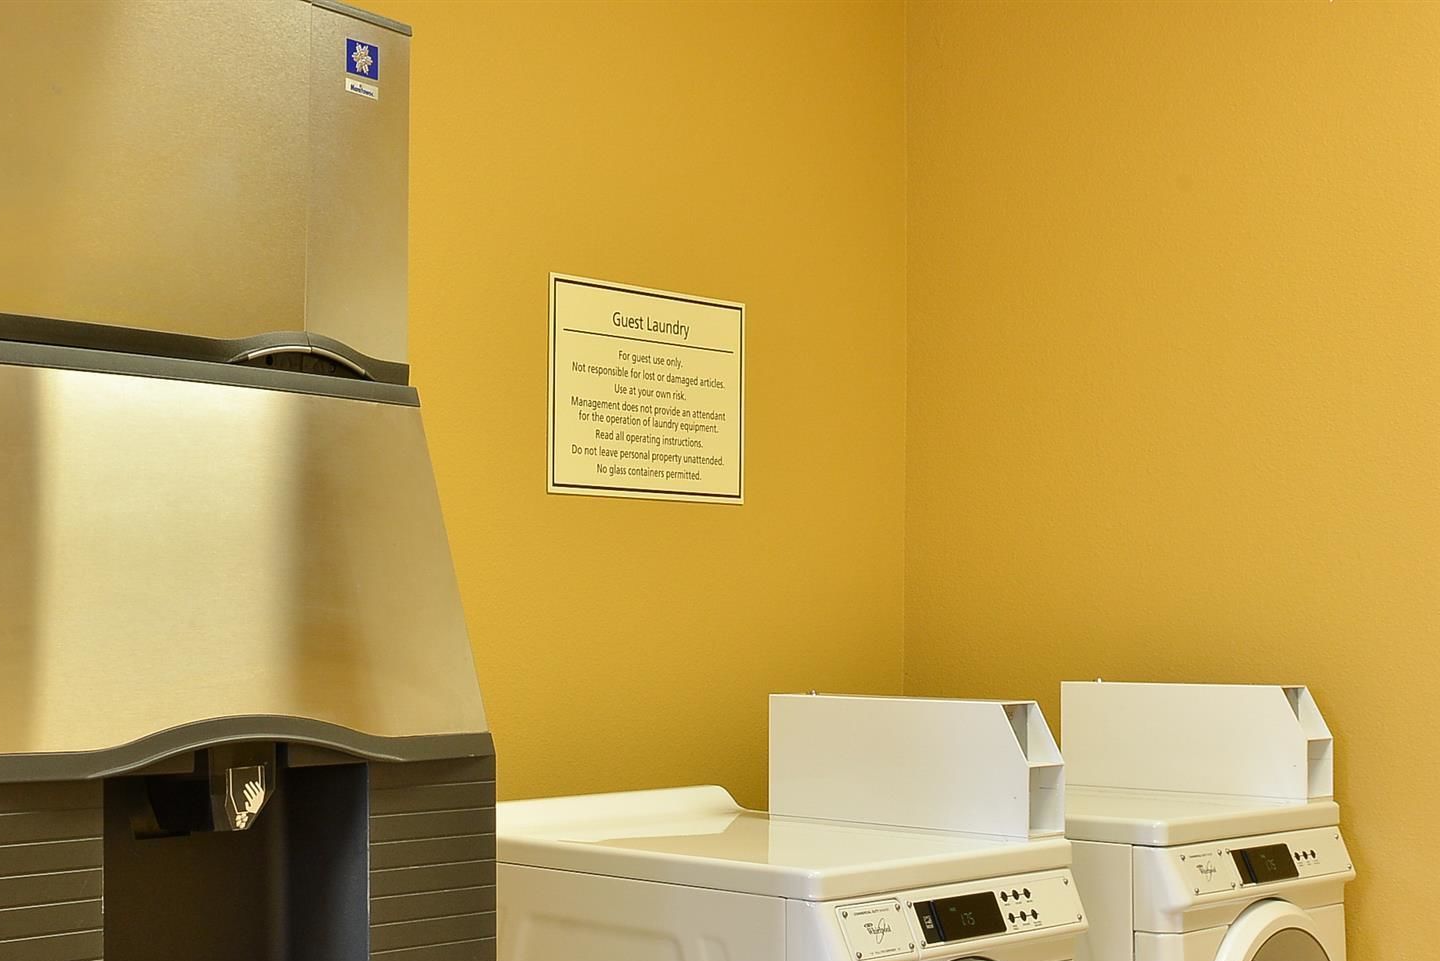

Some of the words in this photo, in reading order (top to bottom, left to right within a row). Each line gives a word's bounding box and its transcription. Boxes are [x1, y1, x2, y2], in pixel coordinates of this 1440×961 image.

[612, 311, 644, 330] Guest
[647, 317, 690, 340] Laundry
[618, 350, 630, 360] For
[632, 354, 651, 364] guest
[653, 357, 665, 365] use
[666, 357, 683, 370] only.
[572, 361, 586, 372] Not
[588, 365, 628, 377] responsible
[630, 368, 640, 378] for
[642, 370, 655, 380] lost
[657, 373, 665, 382] or
[666, 373, 698, 387] damaged
[700, 378, 725, 388] articles.
[614, 384, 627, 394] Use
[629, 386, 636, 396] at
[638, 388, 654, 398] your
[656, 390, 671, 399] own
[673, 390, 686, 400] risk.
[571, 396, 620, 410] Management
[622, 401, 638, 412] does
[640, 404, 653, 414] not
[654, 406, 680, 416] provide
[692, 410, 726, 421] attendant
[579, 410, 590, 420] for
[592, 412, 604, 422] the
[606, 415, 641, 426] operation
[642, 417, 651, 426] of
[652, 417, 679, 432] laundry
[680, 422, 719, 433] equipment.
[595, 429, 614, 440] Read
[616, 431, 624, 440] all
[626, 433, 660, 447] operating
[662, 435, 703, 448] instructions.
[572, 444, 582, 454] Do
[584, 447, 597, 456] not
[599, 445, 618, 458] leave
[620, 450, 650, 460] personal
[652, 452, 682, 465] property
[683, 456, 724, 466] unattended.
[596, 464, 607, 474] No
[609, 464, 626, 476] glass
[628, 467, 664, 478] containers
[666, 470, 702, 480] permitted.
